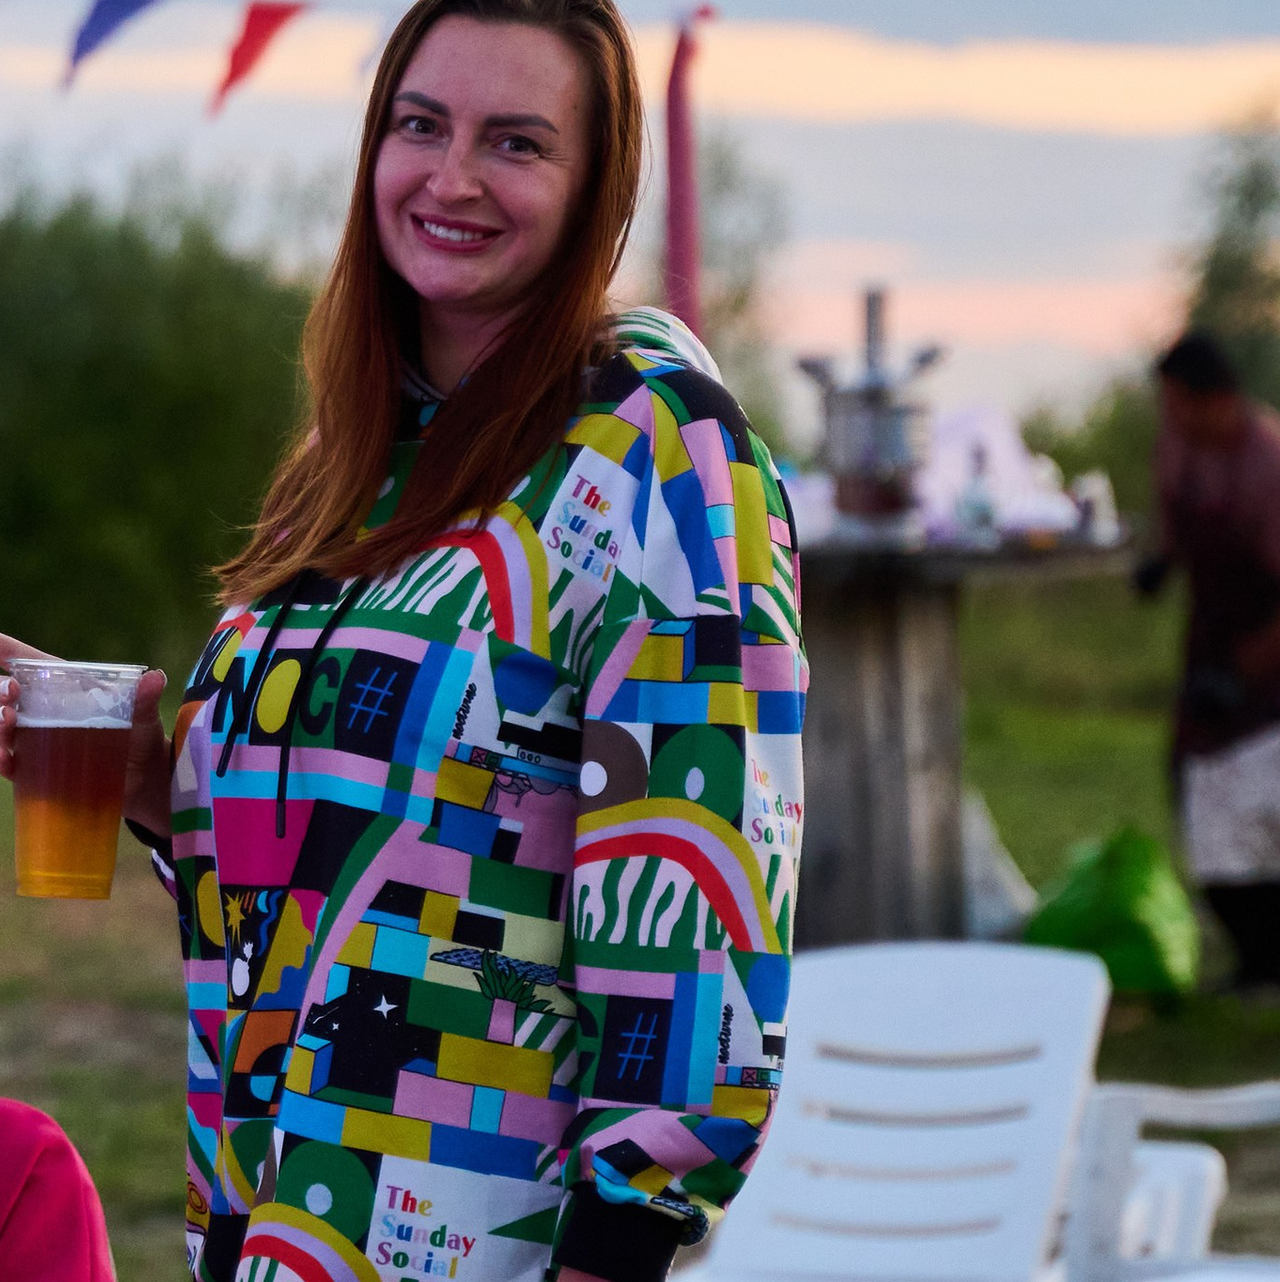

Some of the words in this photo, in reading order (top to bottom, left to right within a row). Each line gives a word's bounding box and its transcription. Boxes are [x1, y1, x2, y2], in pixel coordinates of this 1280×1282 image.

[572, 474, 612, 517] The
[557, 500, 622, 559] Sunda
[547, 526, 612, 582] Social
[386, 1184, 433, 1216] The
[380, 1214, 476, 1258] Sunday
[375, 1241, 459, 1279] Social
